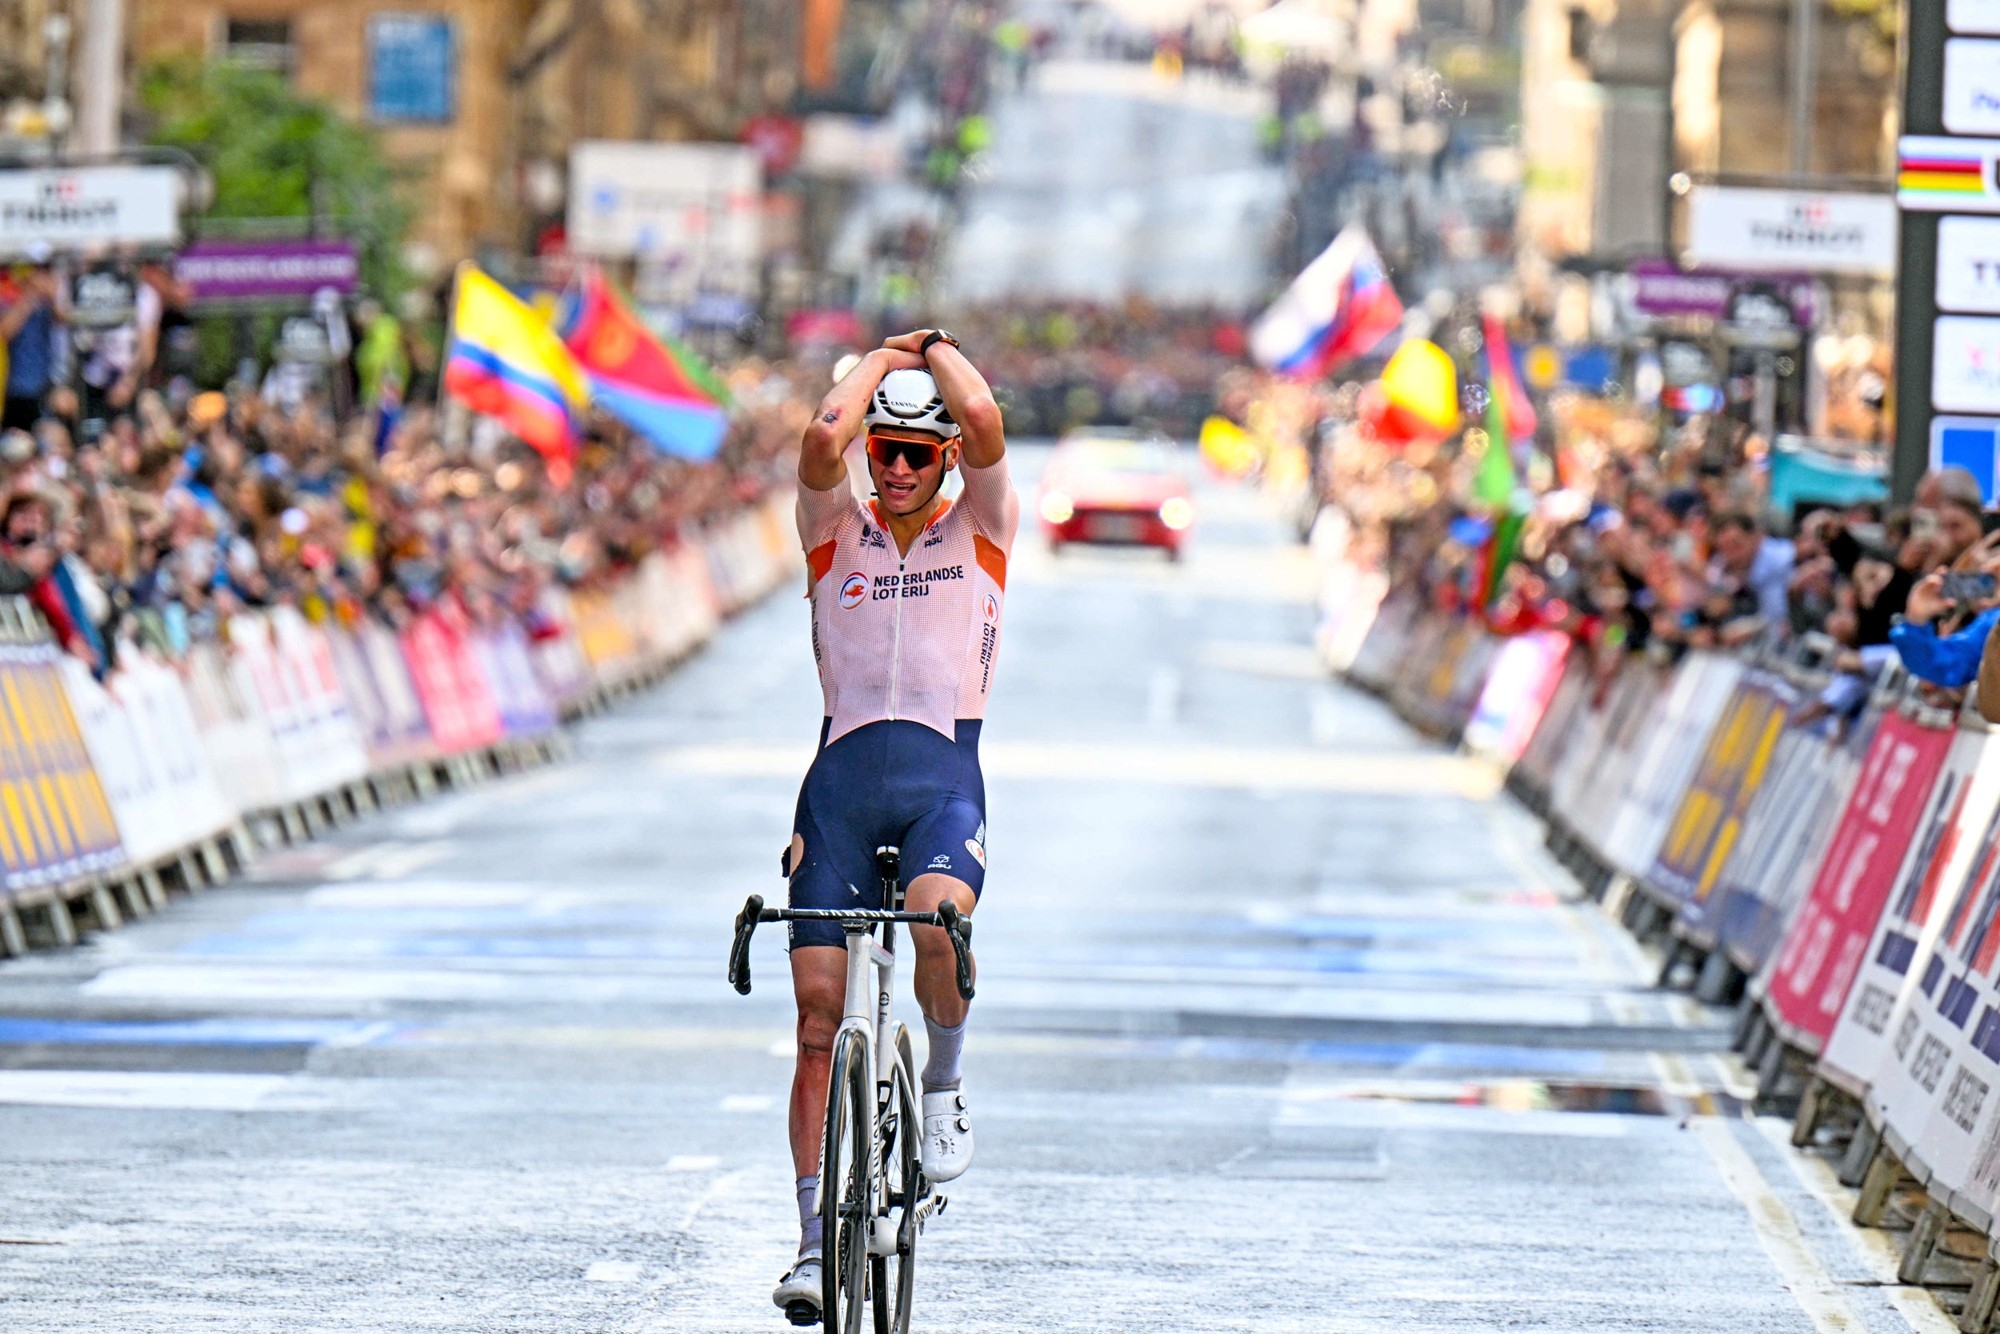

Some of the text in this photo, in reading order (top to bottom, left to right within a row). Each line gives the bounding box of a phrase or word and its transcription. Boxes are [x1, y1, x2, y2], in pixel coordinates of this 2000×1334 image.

[890, 401, 919, 409] CANYON
[924, 535, 943, 548] AGU
[874, 565, 964, 587] NEDERLANDSE
[872, 584, 929, 601] LOTERIJ
[980, 622, 990, 665] LOTERIJ
[980, 626, 997, 695] NEDERLANDSE
